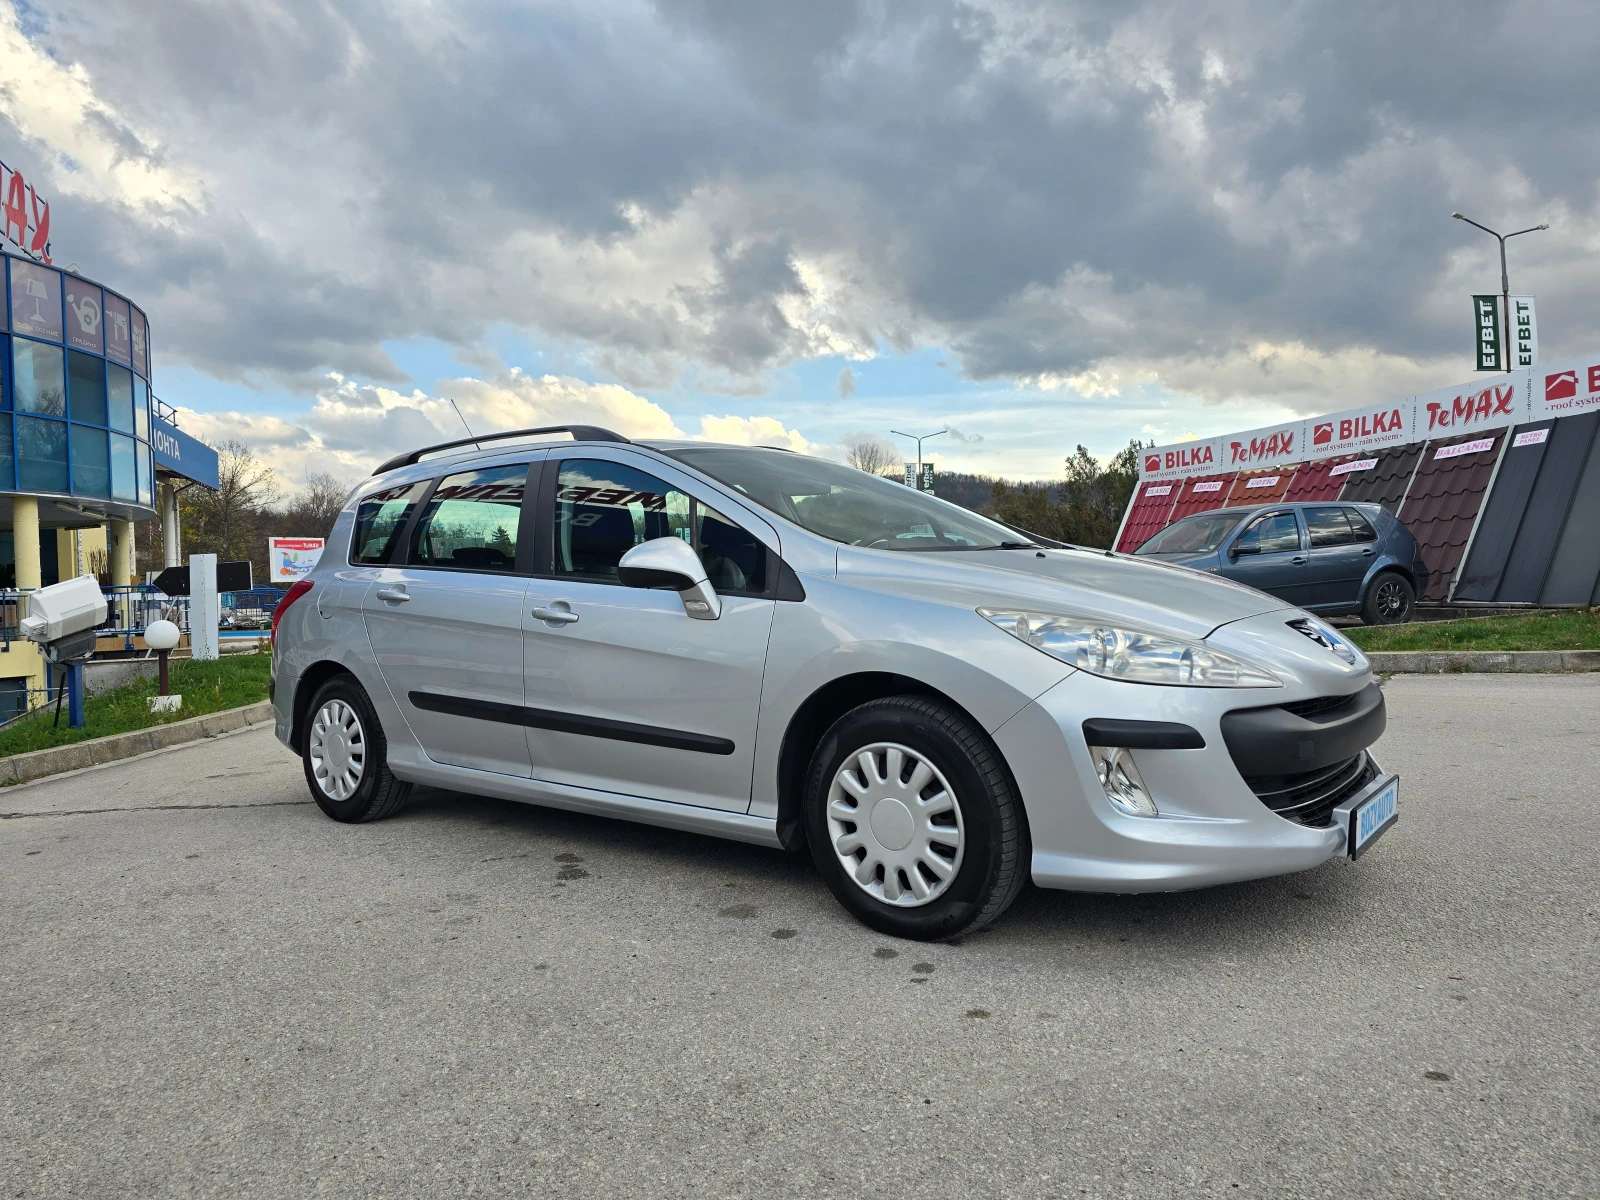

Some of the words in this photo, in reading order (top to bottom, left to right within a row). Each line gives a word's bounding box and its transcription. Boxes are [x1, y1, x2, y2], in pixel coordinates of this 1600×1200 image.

[0, 164, 52, 266] AX
[1480, 300, 1495, 366] EFBET
[1516, 300, 1531, 365] EFBET
[72, 336, 97, 349] ГРАДИНА
[1426, 384, 1514, 432] TeMAX
[1551, 399, 1573, 411] roof
[1339, 409, 1402, 440] BILKA
[1230, 432, 1294, 466] TeMAX
[1316, 445, 1329, 453] roof
[1330, 442, 1354, 452] system
[1359, 438, 1373, 446] rain
[1374, 434, 1399, 444] system
[1436, 440, 1493, 457] BALCANIC
[1165, 446, 1213, 469] BILKA
[1159, 470, 1177, 478] system
[1192, 466, 1211, 474] system
[1333, 461, 1375, 474] ROMANIC
[1147, 487, 1170, 495] CLASIC
[1195, 483, 1219, 491] IBERIC
[1251, 478, 1275, 486] GOTIC
[1361, 789, 1394, 840] BOZYAUTO
